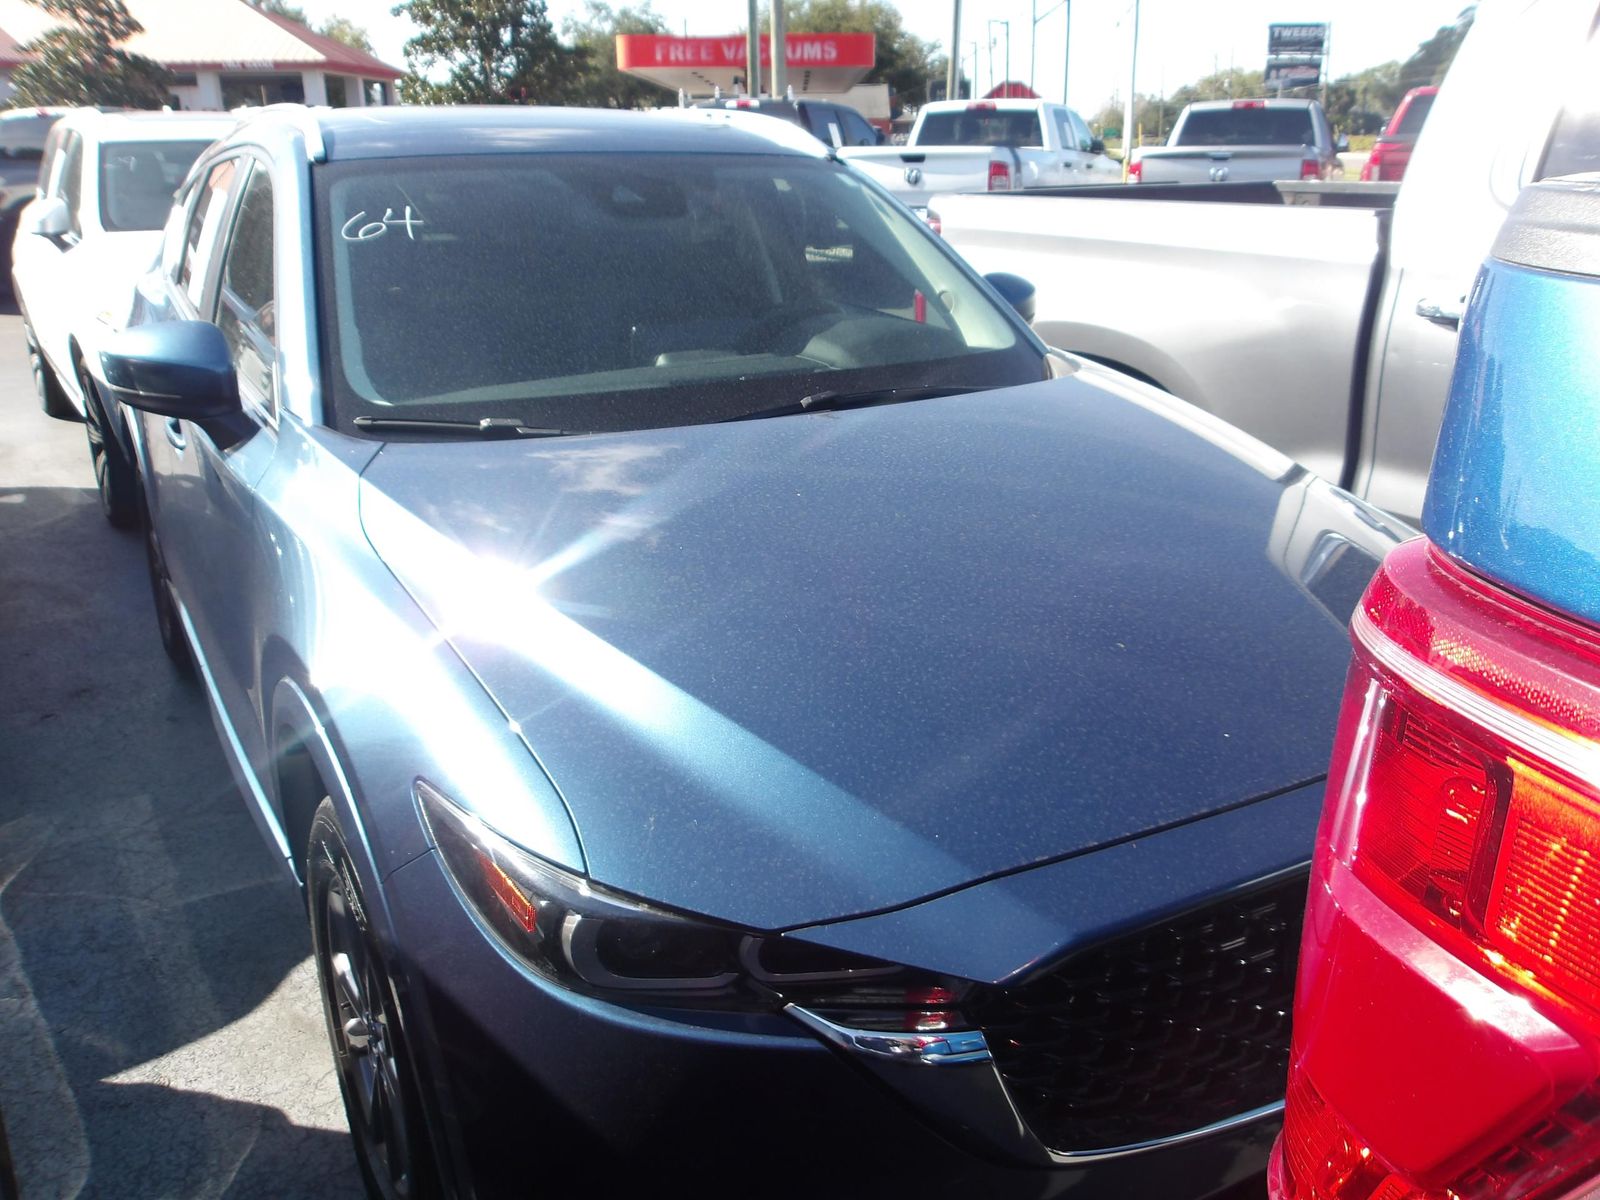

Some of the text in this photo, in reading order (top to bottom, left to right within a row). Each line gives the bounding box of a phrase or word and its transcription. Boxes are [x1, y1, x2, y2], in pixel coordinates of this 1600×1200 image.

[655, 40, 838, 62] FREE VACUMS
[341, 205, 424, 240] 64
